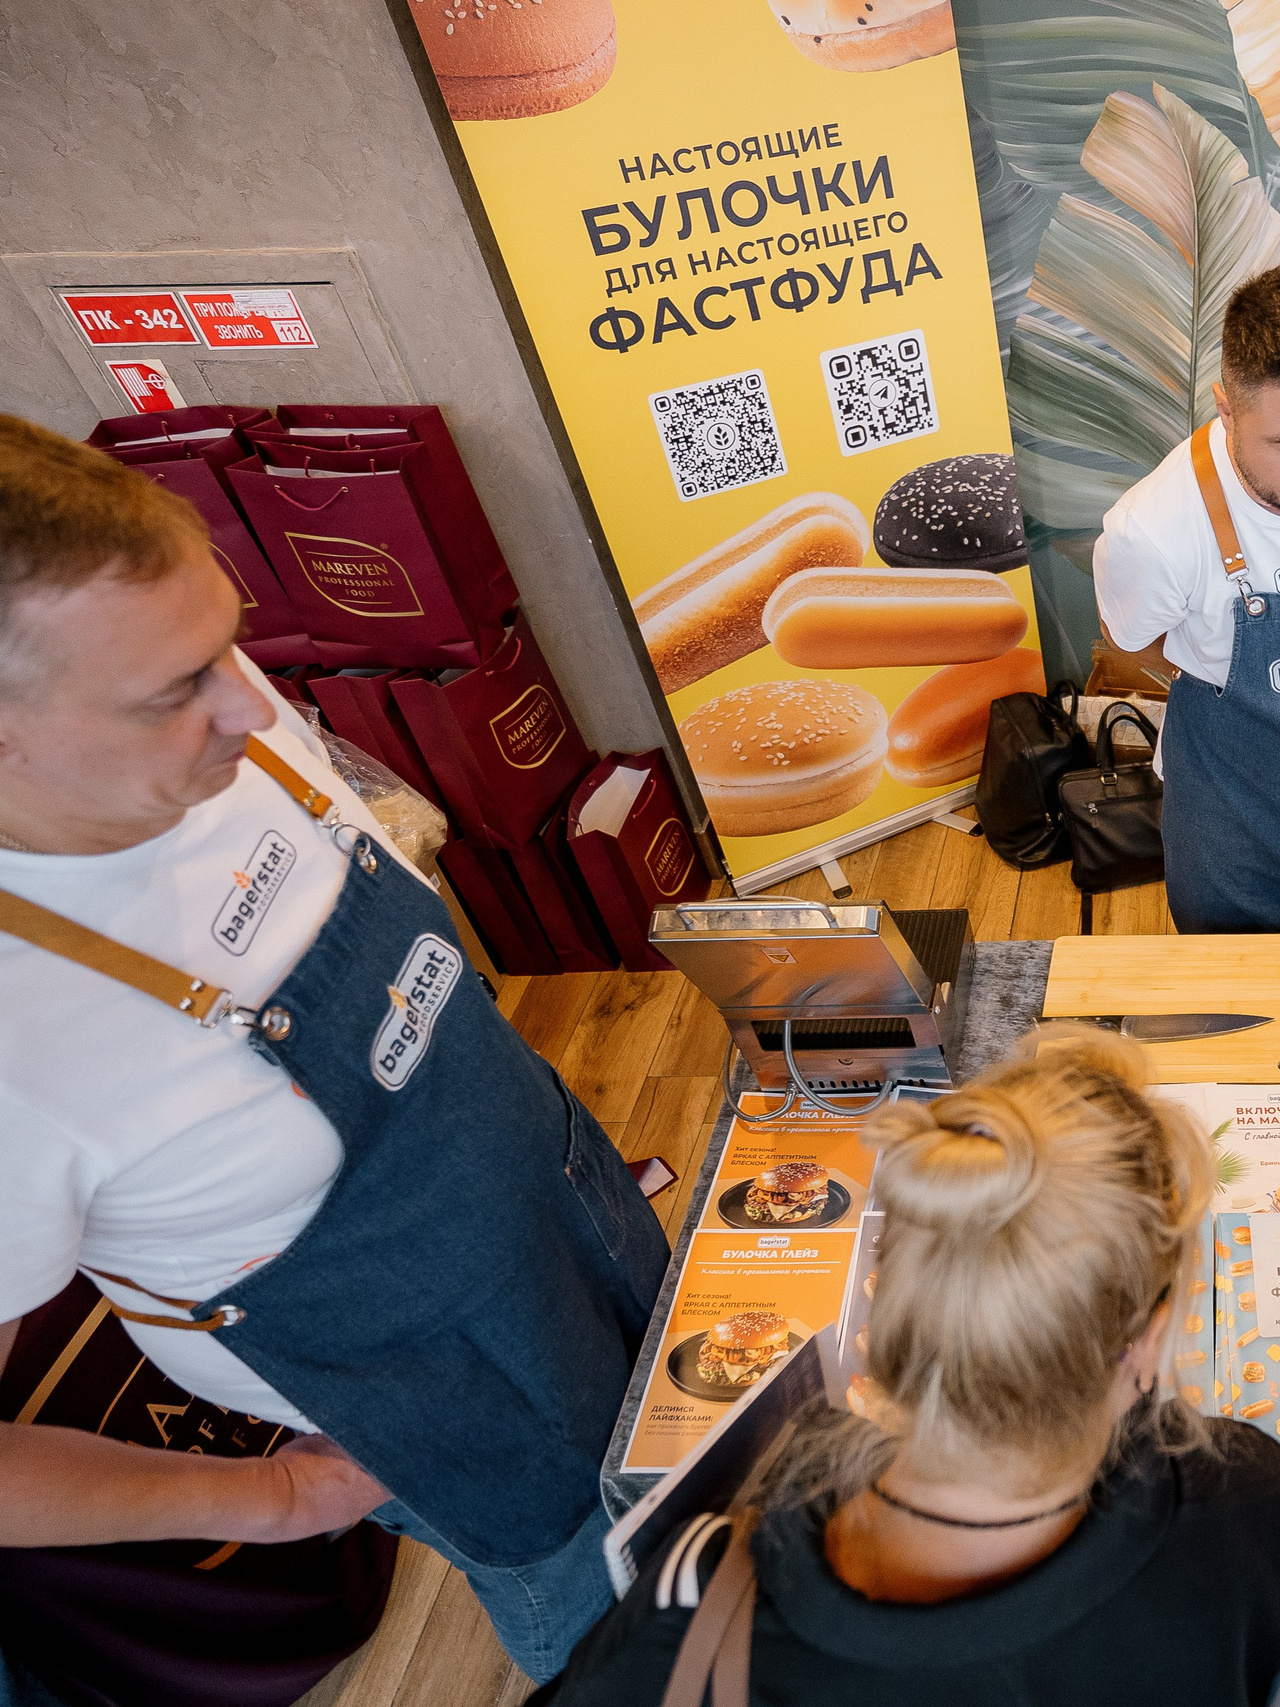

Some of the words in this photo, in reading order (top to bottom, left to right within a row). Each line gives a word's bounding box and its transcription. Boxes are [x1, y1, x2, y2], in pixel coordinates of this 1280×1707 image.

[619, 122, 842, 184] НАСТОЯЩИЕ
[581, 155, 895, 257] БУЛОЧКИ
[604, 257, 679, 298] ДЛЯ
[688, 210, 909, 277] НАСТОЯЩЕГО
[588, 242, 943, 354] ФАСТФУДА
[193, 302, 217, 318] ПРИ
[77, 310, 121, 330] ПК
[135, 308, 184, 329] 342
[214, 324, 264, 339] ЗВОНИТЬ
[279, 326, 306, 341] 112
[311, 559, 389, 576] MAREVEN
[318, 575, 395, 588] PROFESSIONAL
[345, 588, 375, 598] FOOD
[508, 696, 548, 745] MAREVEN
[220, 841, 285, 944] bagerstat
[419, 961, 456, 1034] FOODSERVICE
[378, 949, 447, 1074] bagerstat
[1237, 1117, 1255, 1125] НА
[1244, 1132, 1251, 1140] С
[722, 1249, 778, 1259] БУЛОЧКА
[780, 1248, 819, 1258] ГЛЕЙЗ
[743, 1268, 791, 1276] премиальном
